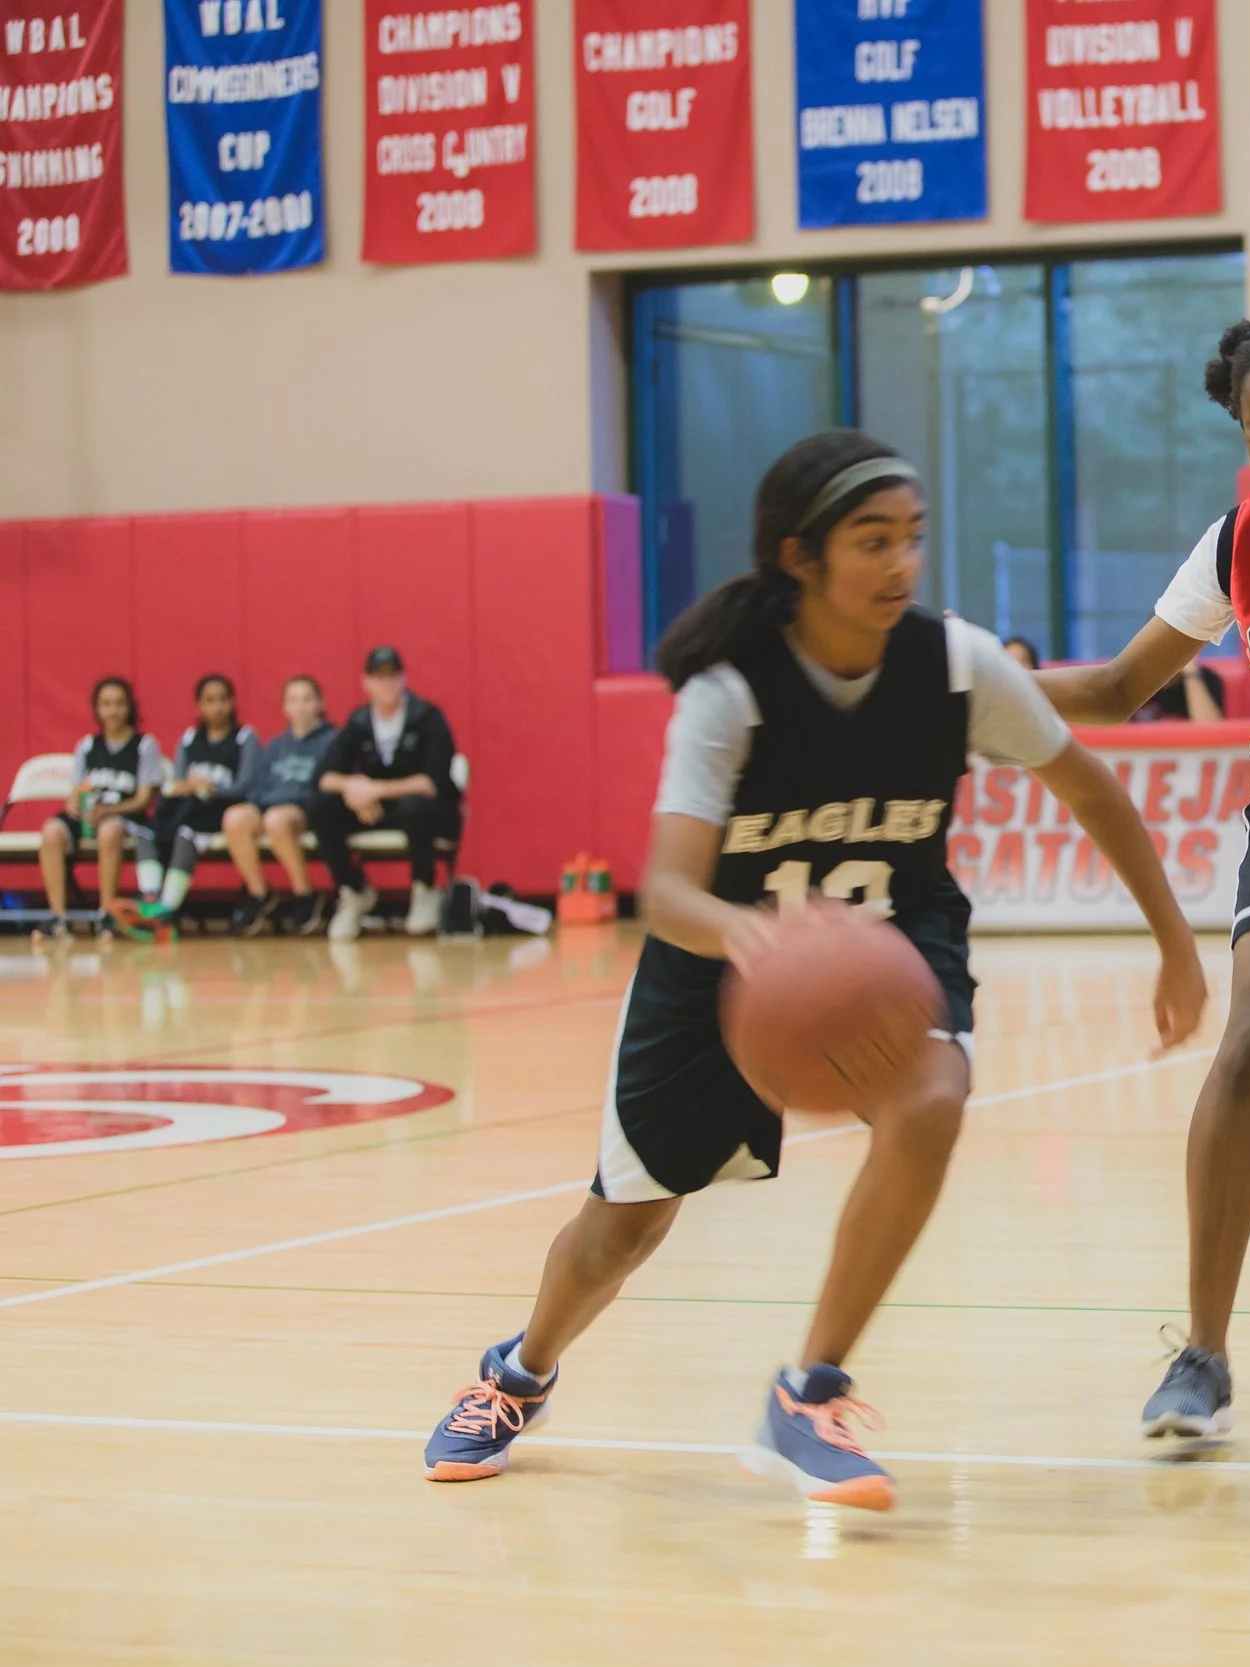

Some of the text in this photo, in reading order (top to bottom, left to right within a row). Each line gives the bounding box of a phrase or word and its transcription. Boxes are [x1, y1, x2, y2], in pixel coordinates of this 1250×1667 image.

[6, 14, 85, 54] WBAL
[199, 0, 284, 36] WBAL
[379, 3, 521, 53] CHAMPIONS
[584, 23, 737, 71] CHAMPIONS
[855, 40, 920, 82] GOLF
[1047, 18, 1192, 66] DIVISION V
[0, 74, 113, 121] HAMPIONS
[378, 65, 520, 114] DIVISION V
[627, 88, 696, 131] GOLF
[1039, 82, 1205, 129] VOLLEYBALL
[219, 131, 270, 171] CUP
[377, 133, 435, 174] CROSS
[1087, 147, 1161, 191] 2008
[630, 174, 697, 217] 2008
[857, 159, 922, 203] 2008
[417, 189, 483, 232] 2008
[721, 797, 947, 853] EAGLES
